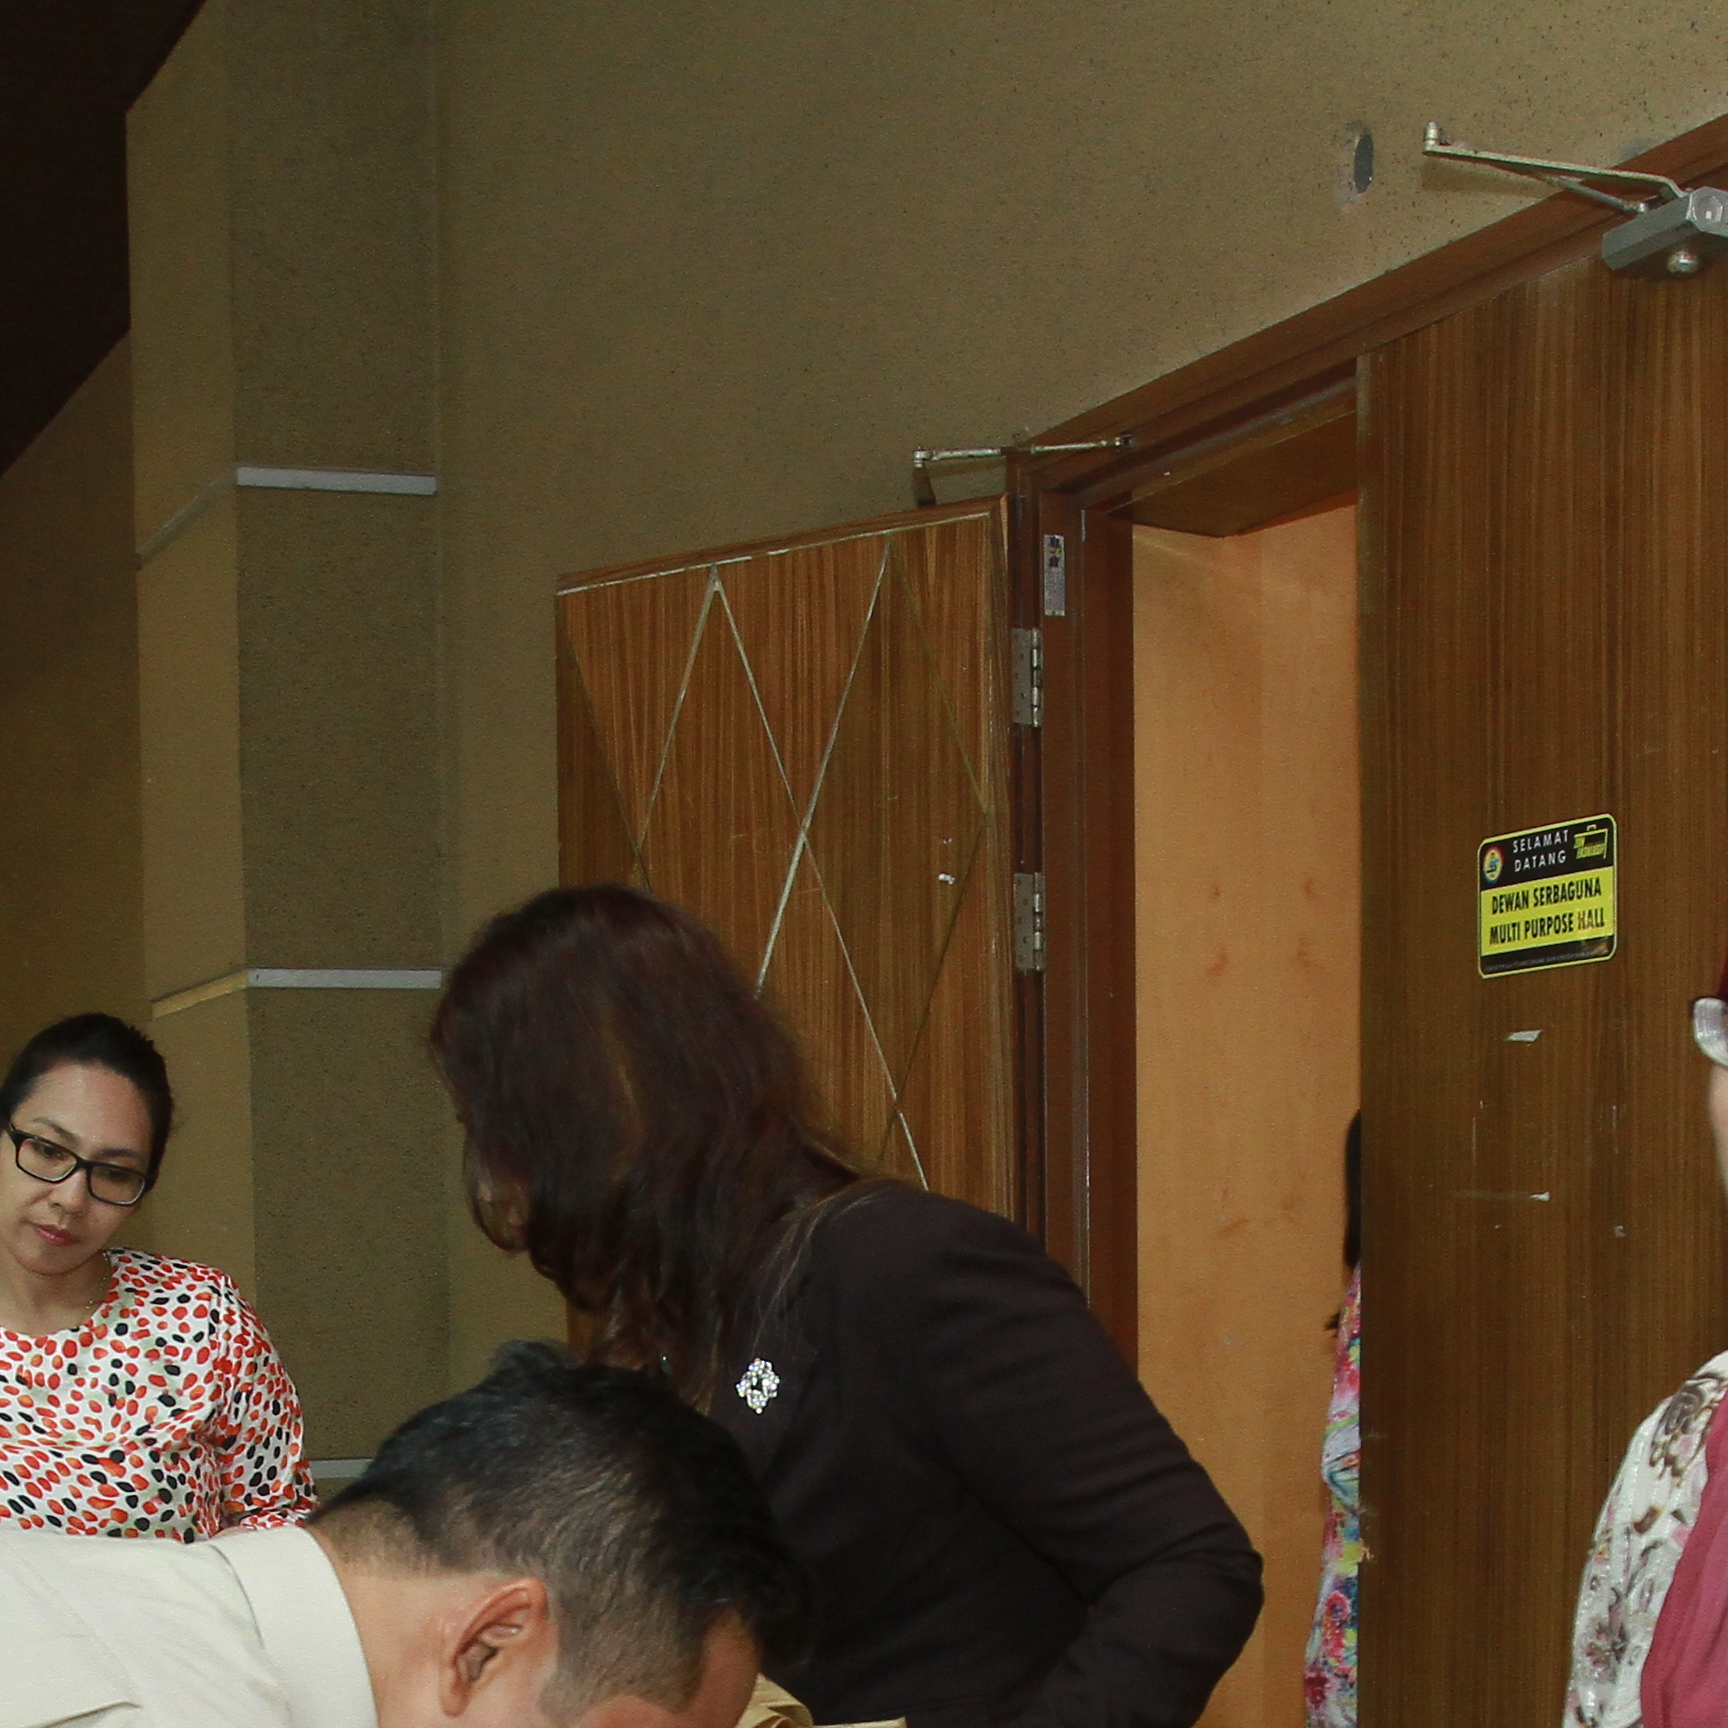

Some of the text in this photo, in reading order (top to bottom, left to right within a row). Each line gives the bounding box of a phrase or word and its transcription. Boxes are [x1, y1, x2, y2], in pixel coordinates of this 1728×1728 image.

[1513, 829, 1569, 853] SELAMAT
[1514, 850, 1567, 872] DATANG
[1492, 877, 1602, 915] DEWAN SERBAGUNA
[1489, 907, 1606, 945] MULTI PURPOSE HALL
